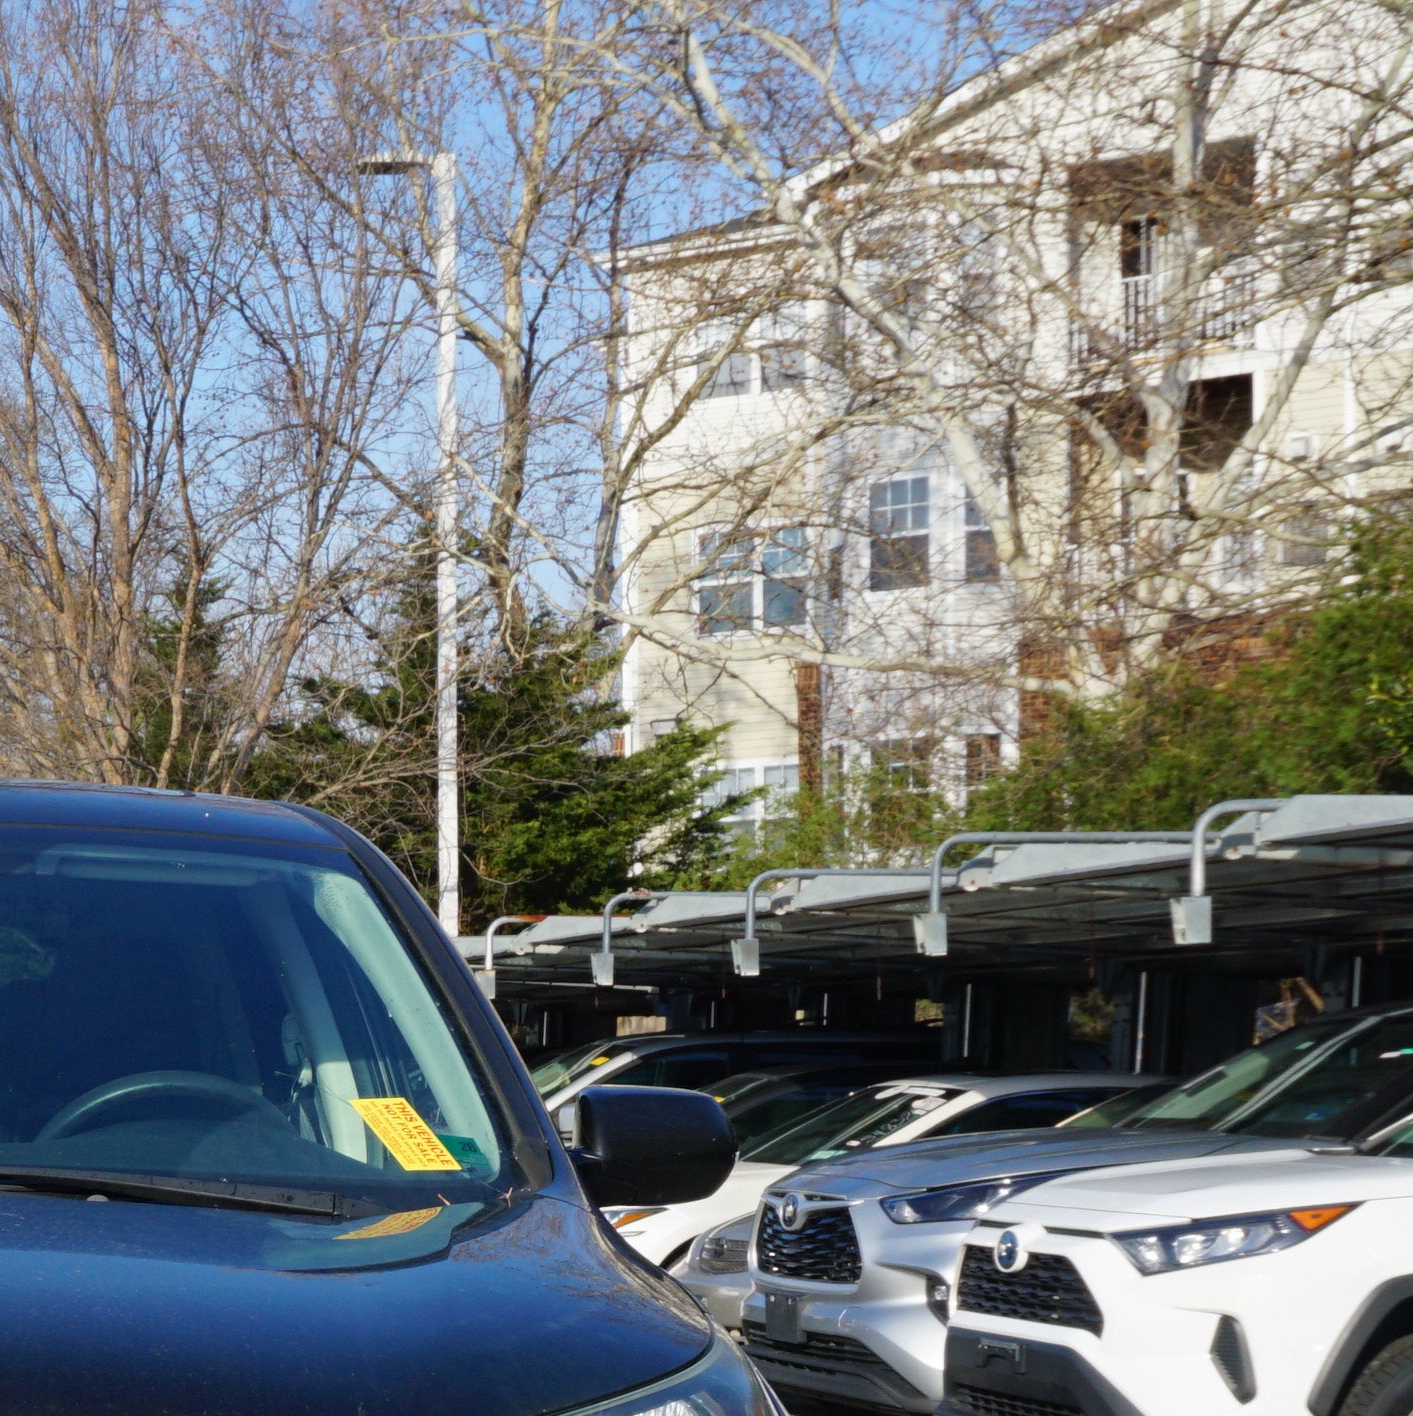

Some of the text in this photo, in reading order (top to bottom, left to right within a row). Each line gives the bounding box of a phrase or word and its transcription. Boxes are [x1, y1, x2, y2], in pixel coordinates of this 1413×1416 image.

[381, 1103, 437, 1164] NOT FOR SALE
[392, 1102, 418, 1123] THIS
[413, 1123, 454, 1166] VEHICLE
